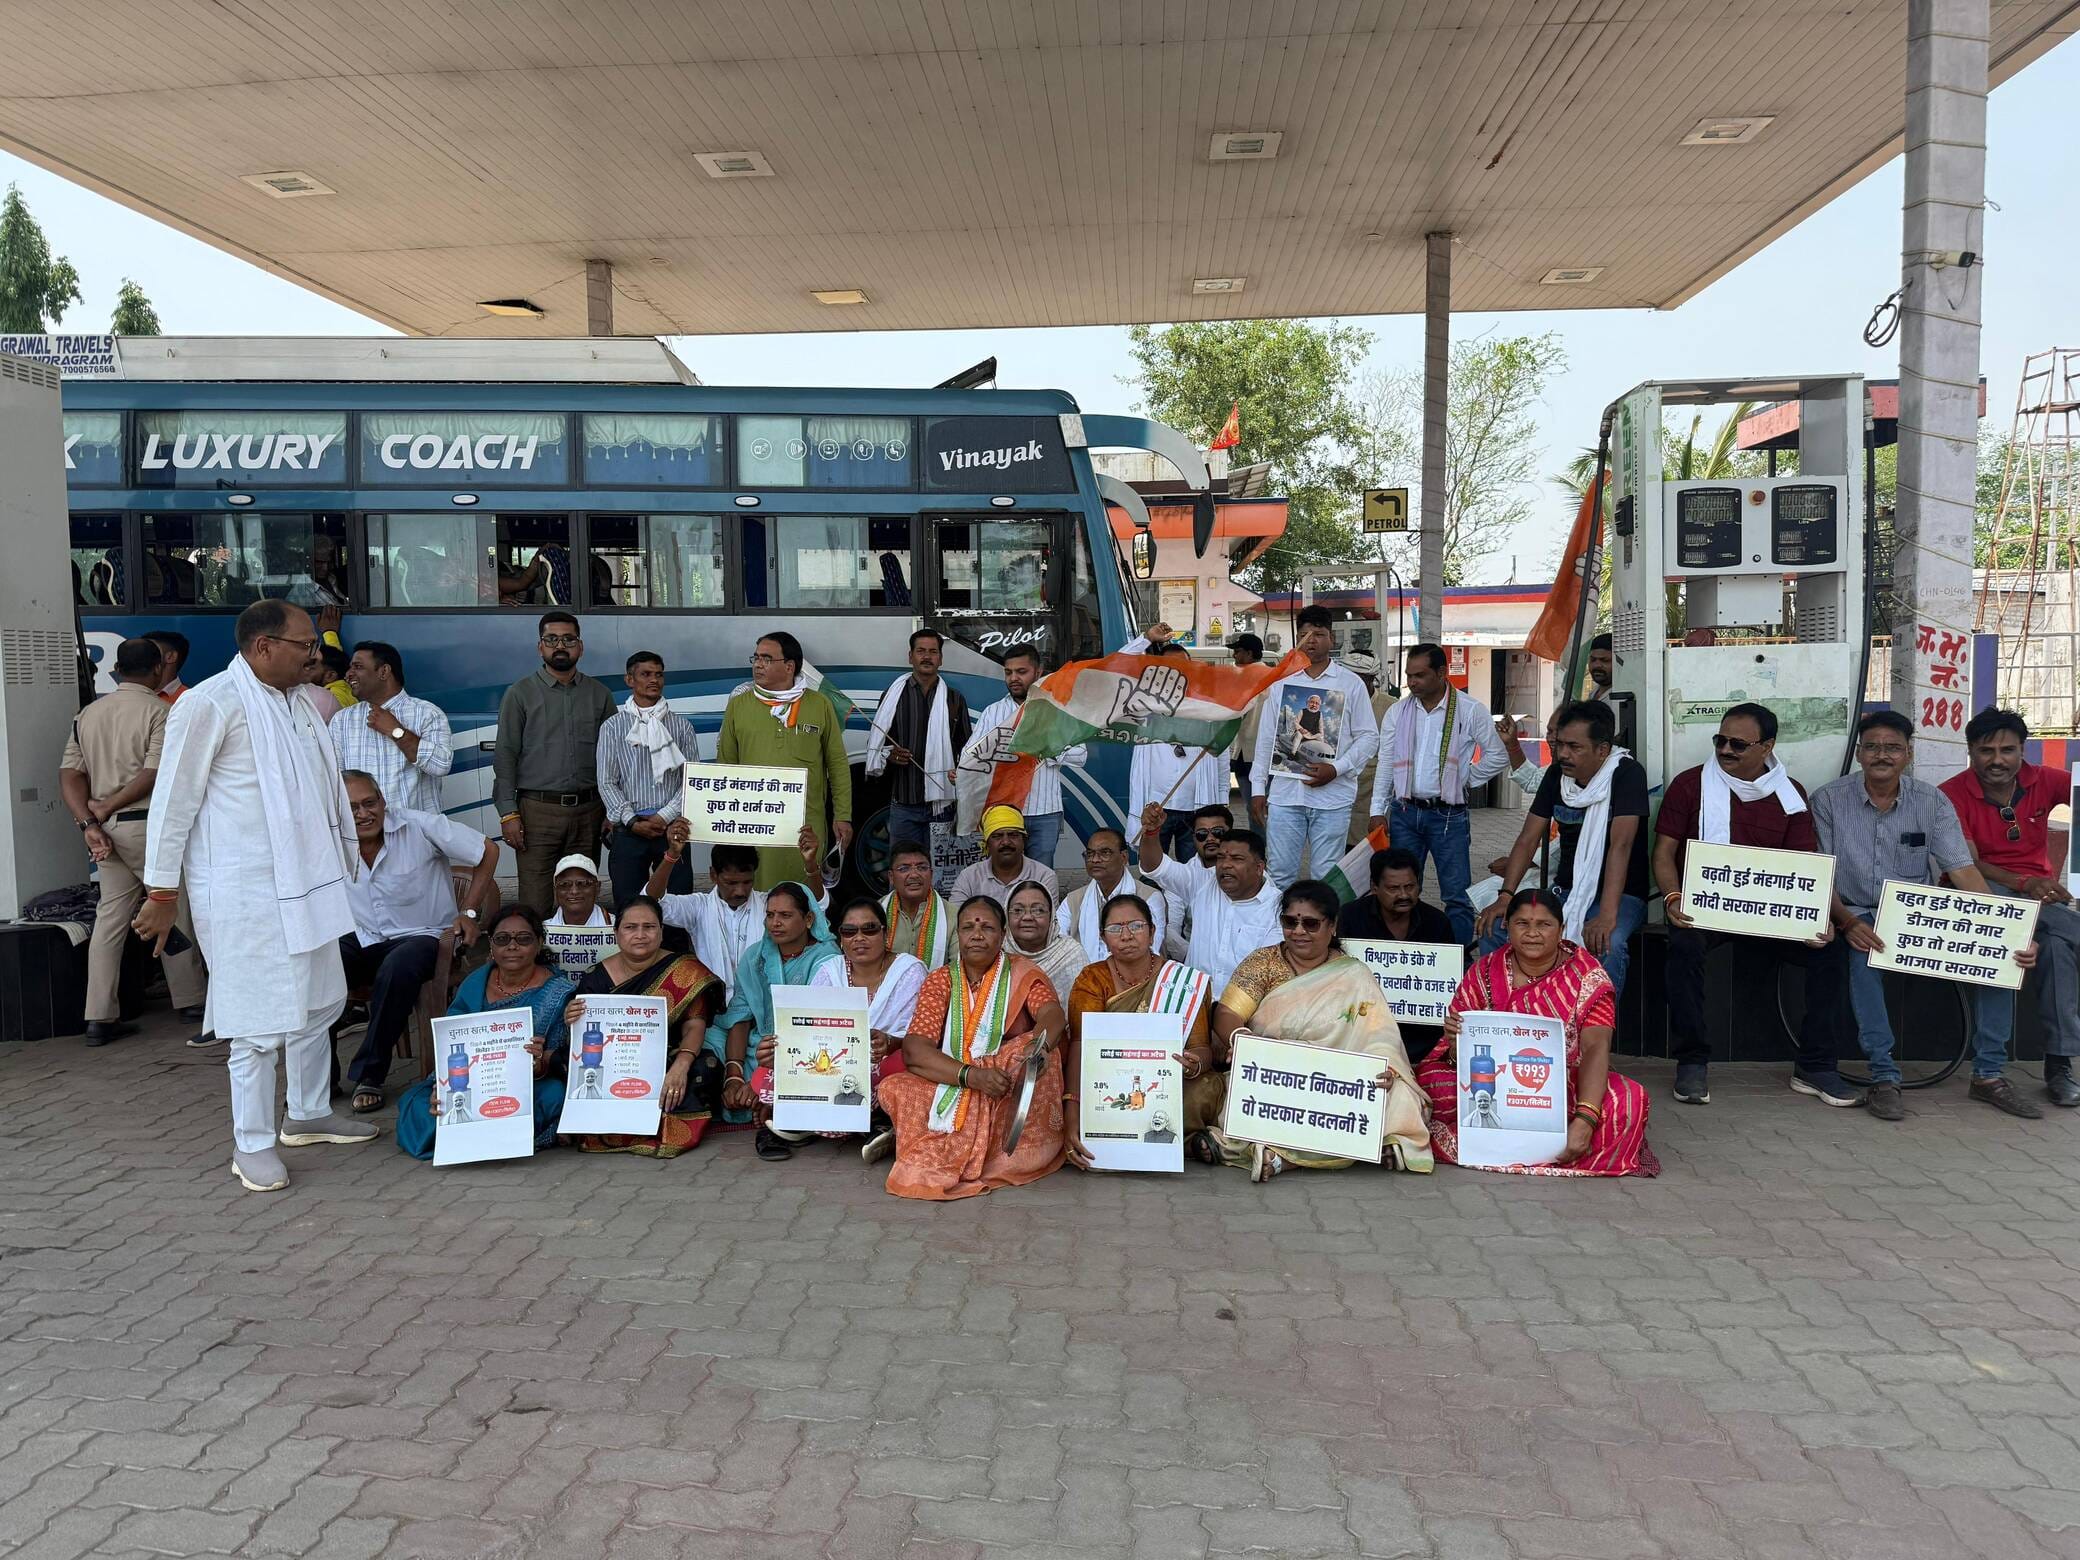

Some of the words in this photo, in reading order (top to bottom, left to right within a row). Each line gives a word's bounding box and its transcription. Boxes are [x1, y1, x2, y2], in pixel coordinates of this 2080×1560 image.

[0, 336, 51, 355] GRAWAL
[55, 335, 114, 354] TRAVELS
[27, 354, 114, 366] NDRAGRAM
[140, 433, 336, 470] LUXURY
[380, 433, 539, 470] COACH
[939, 439, 1043, 471] Vinayak
[1622, 403, 1632, 497] REEN
[1366, 518, 1407, 529] PETROL
[978, 624, 1046, 654] Pilot
[1687, 704, 1729, 715] XTRAGR
[1921, 697, 1963, 732] 288
[688, 777, 711, 791] बहुत
[712, 776, 728, 792] हुई
[730, 777, 764, 792] मंहगाई
[767, 779, 781, 792] की
[782, 782, 803, 793] मार
[707, 799, 727, 813] कुछ
[729, 798, 741, 812] तो
[743, 799, 763, 812] शर्म
[764, 801, 786, 814] करो
[712, 820, 736, 833] मोदी
[738, 823, 776, 834] सरकार
[1701, 865, 1732, 884] बढ़ती
[1733, 868, 1751, 888] हुई
[1753, 870, 1796, 891] मंहगाई
[1797, 876, 1816, 892] पर
[1692, 890, 1720, 910] मोदी
[1722, 897, 1767, 916] सरकार
[1769, 903, 1793, 919] हाय
[1795, 906, 1819, 921] हाय
[1896, 891, 1927, 907] बहुत
[1929, 894, 1951, 911] हुई
[1952, 897, 1993, 915] पेट्रोल
[1995, 903, 2026, 921] और
[1906, 911, 1950, 931] डीजल
[1951, 918, 1972, 934] की
[1974, 923, 2005, 939] मार
[549, 933, 573, 945] रहकर
[575, 931, 604, 946] आसमां
[1896, 933, 1925, 948] कुछ
[1927, 935, 1944, 951] तो
[1946, 940, 1977, 955] शर्म
[1978, 945, 2008, 960] करो
[562, 949, 589, 964] दिखाते
[590, 949, 599, 964] हैं
[1364, 947, 1398, 967] विश्वगुरु
[1400, 949, 1409, 964] के
[1411, 950, 1425, 967] डंके
[1426, 952, 1438, 967] में
[1895, 953, 1942, 970] भाजपा
[1944, 961, 1998, 979] सरकार
[1383, 974, 1412, 990] खराबी
[1413, 976, 1423, 991] के
[1425, 979, 1445, 993] वजह
[1447, 978, 1457, 993] से
[626, 1006, 642, 1016] खेल
[643, 1007, 659, 1018] शुरू
[1407, 1003, 1417, 1016] पा
[1419, 1004, 1434, 1017] रहा
[489, 1022, 506, 1033] खेल
[507, 1021, 524, 1033] शुरू
[1468, 1025, 1490, 1038] चुनाव
[1512, 1025, 1530, 1037] खेल
[1532, 1029, 1550, 1041] शुरू
[1515, 1064, 1546, 1078] ₹993
[1241, 1061, 1258, 1082] जो
[1260, 1067, 1308, 1090] सरकार
[1310, 1071, 1365, 1100] निकम्मी
[1367, 1080, 1377, 1102] है
[1241, 1095, 1256, 1117] वो
[1258, 1101, 1306, 1125] सरकार
[1308, 1111, 1356, 1133] बदलनी
[1358, 1113, 1370, 1135] है
